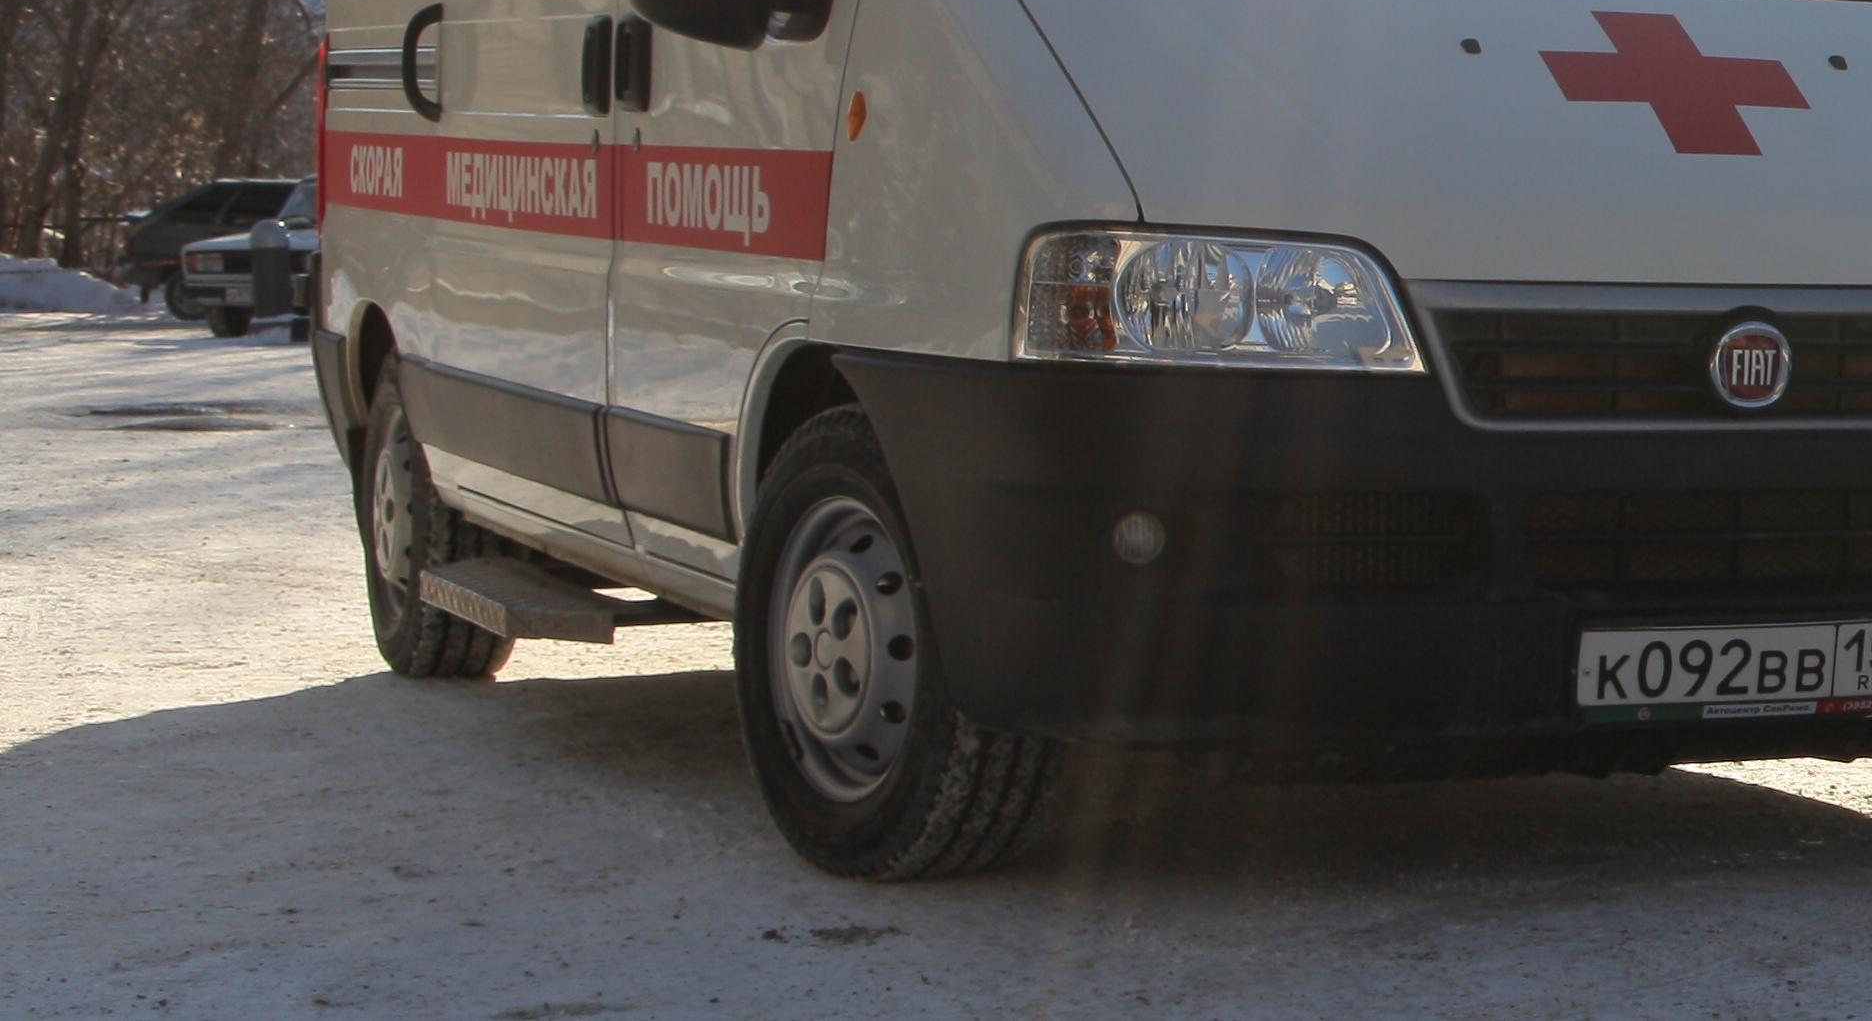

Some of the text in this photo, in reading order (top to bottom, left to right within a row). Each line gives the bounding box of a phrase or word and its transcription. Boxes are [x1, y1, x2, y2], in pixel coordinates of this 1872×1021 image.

[350, 144, 770, 246] СКОРАЯ МЕДИЦИНСКАЯ ПОМОЩЬ
[1731, 349, 1777, 386] FIAT
